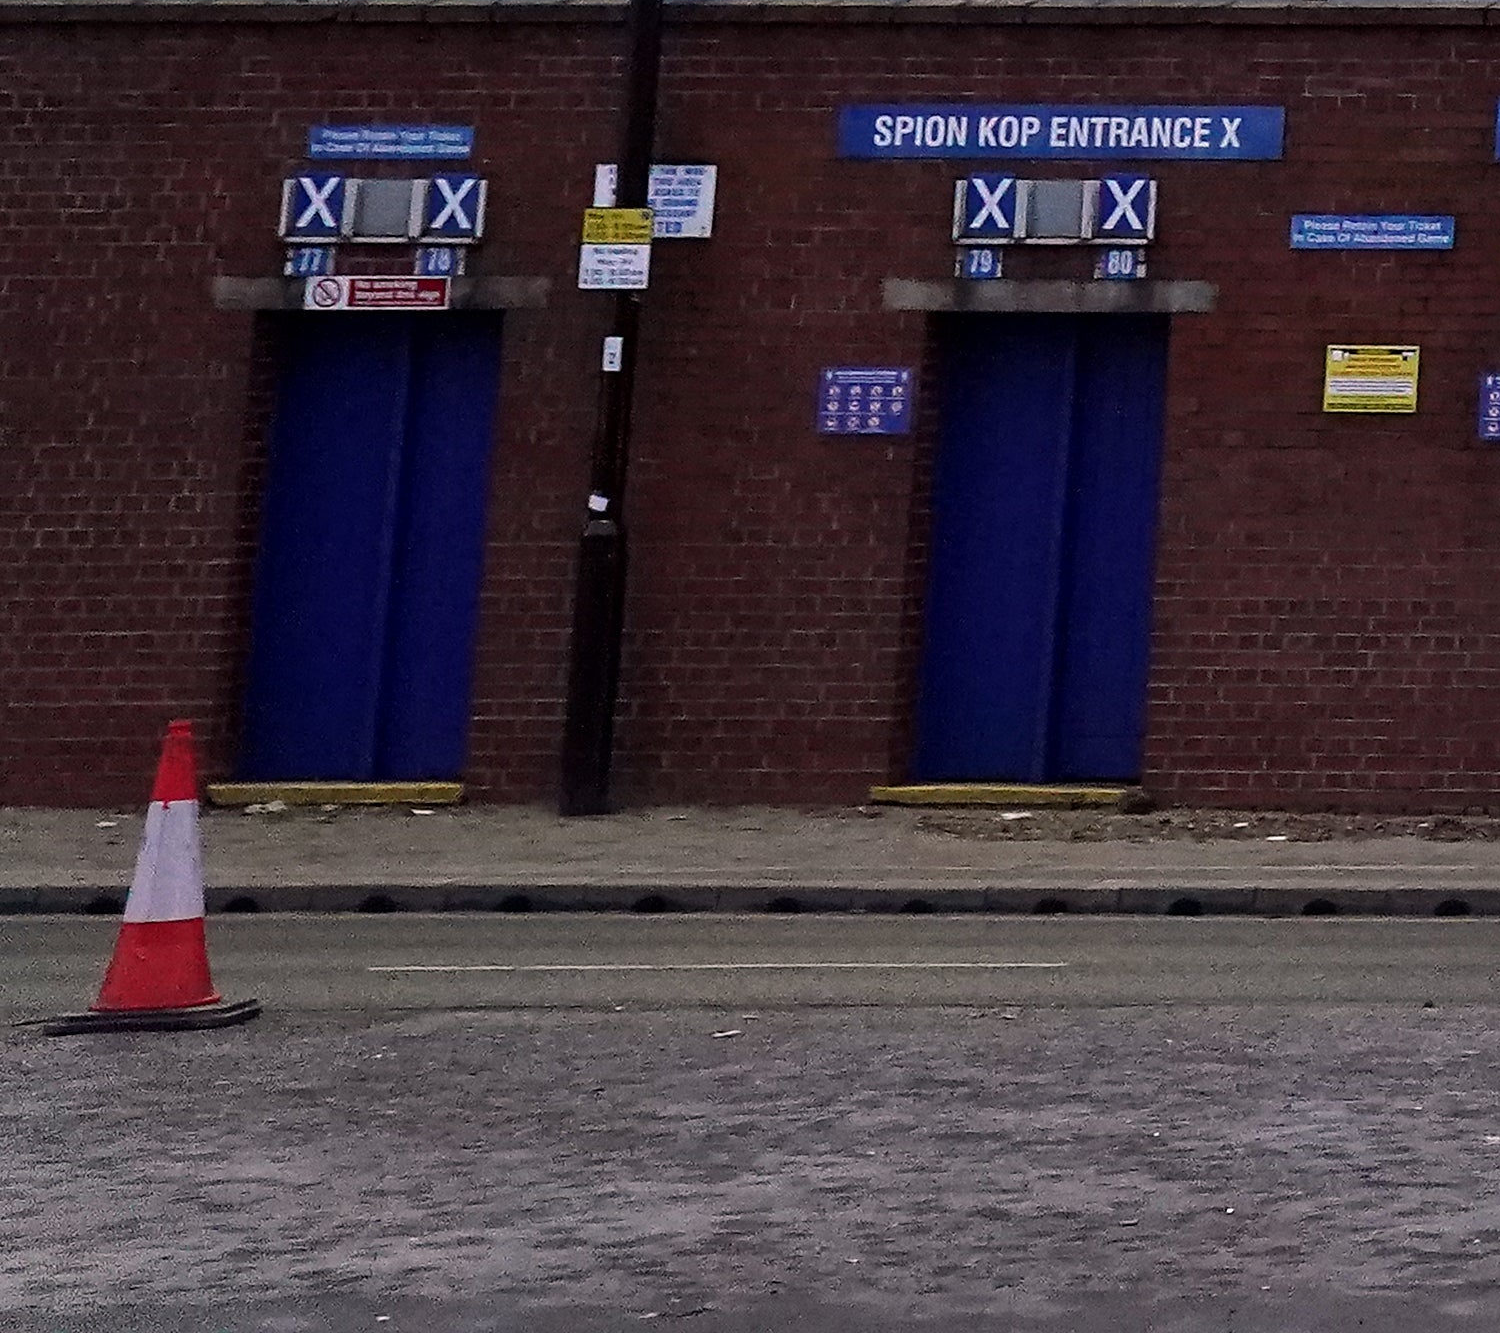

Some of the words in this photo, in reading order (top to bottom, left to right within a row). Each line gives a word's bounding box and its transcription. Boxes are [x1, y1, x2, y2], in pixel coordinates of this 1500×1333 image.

[874, 116, 969, 147] SPION
[978, 117, 1040, 148] KOP
[1050, 118, 1210, 148] ENTRANCE
[1221, 117, 1241, 148] X
[296, 177, 340, 227] X
[430, 178, 476, 228] X
[970, 179, 1014, 228] X
[1103, 180, 1145, 230] X
[1108, 252, 1132, 274] 80
